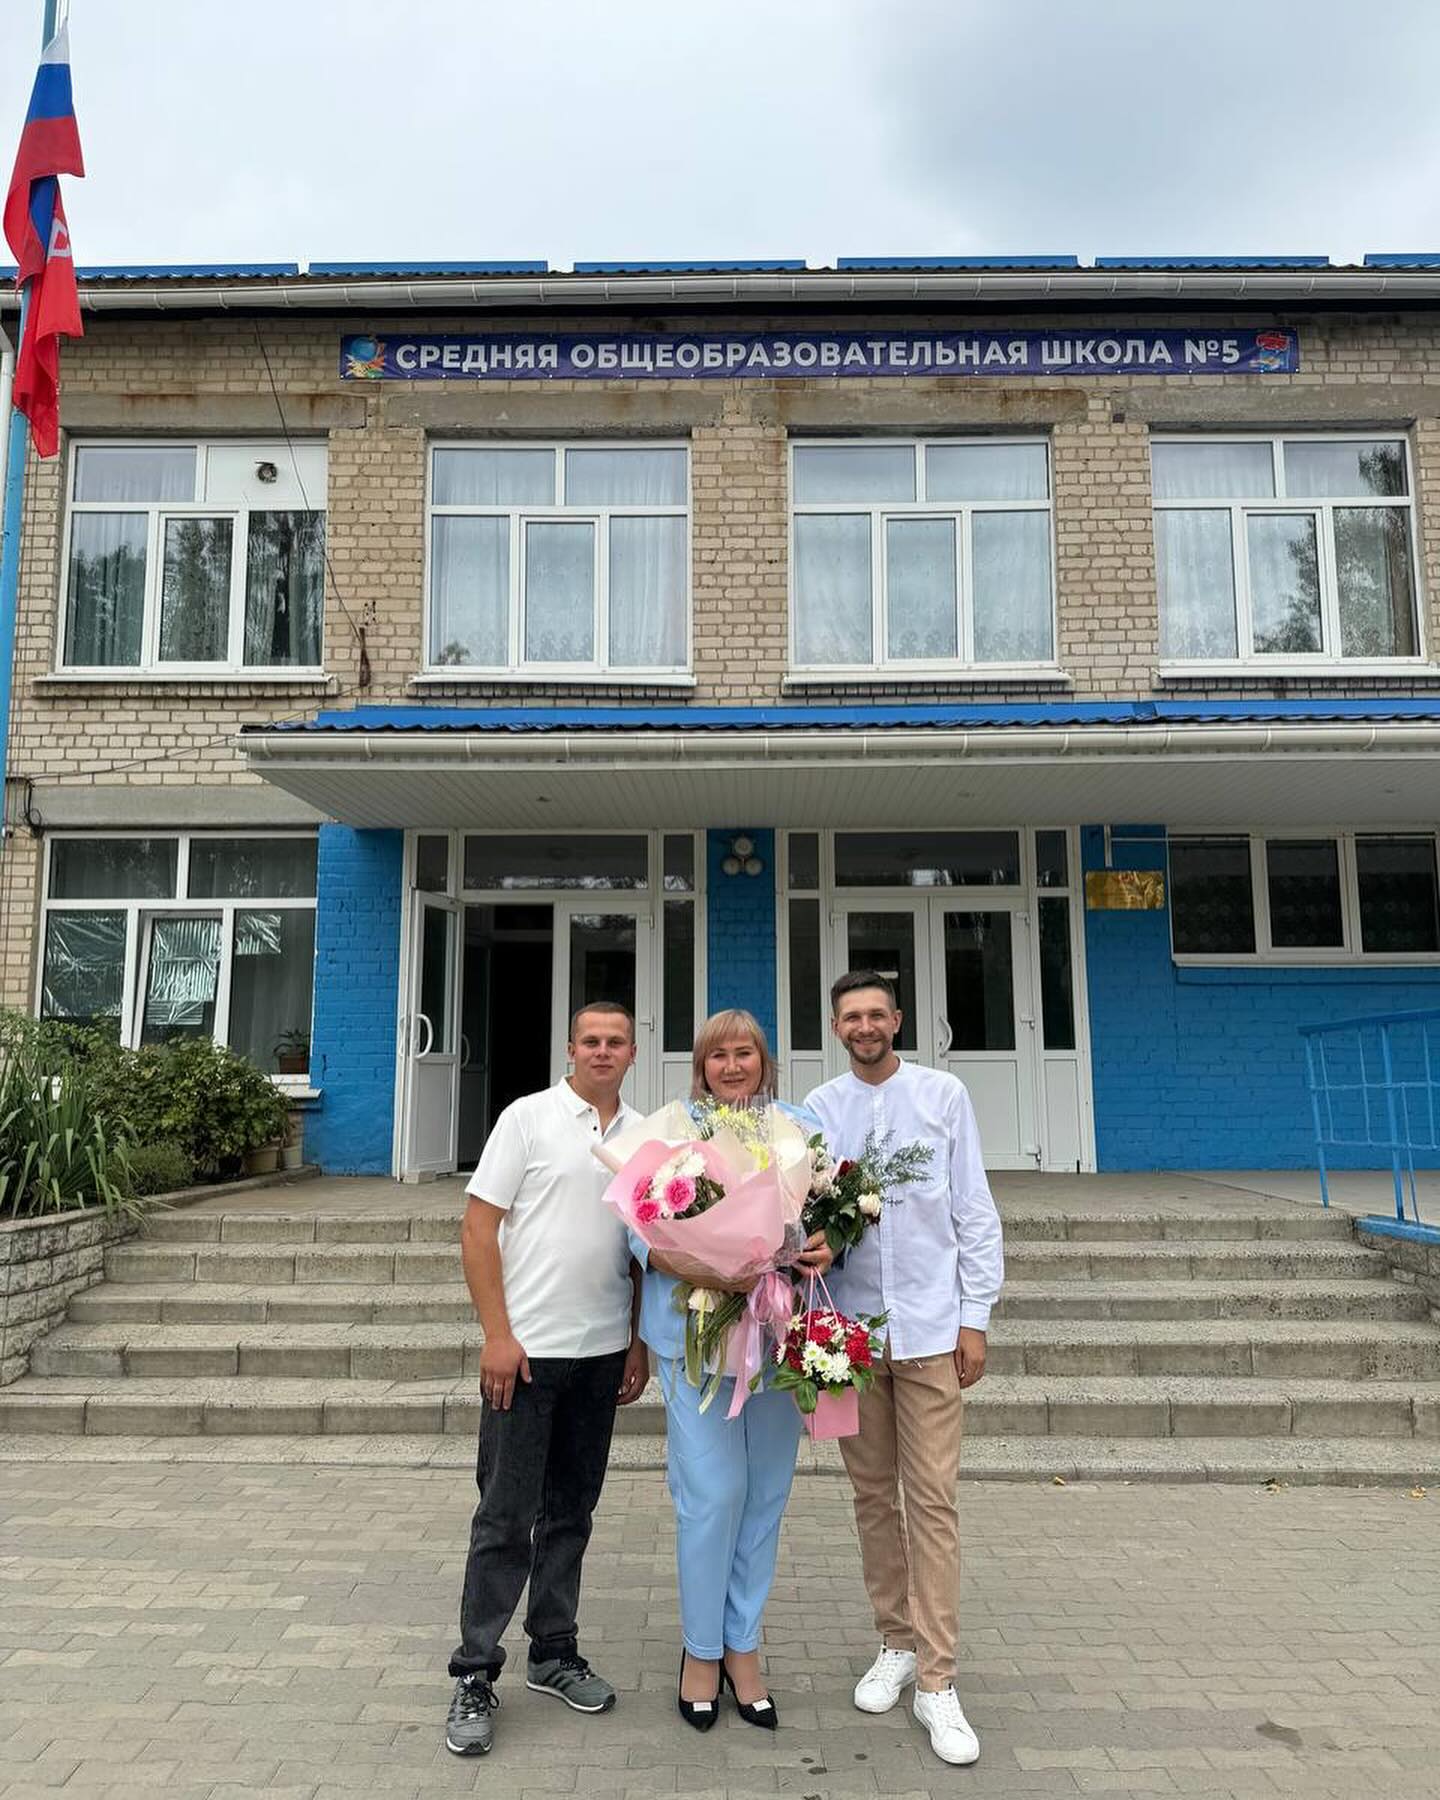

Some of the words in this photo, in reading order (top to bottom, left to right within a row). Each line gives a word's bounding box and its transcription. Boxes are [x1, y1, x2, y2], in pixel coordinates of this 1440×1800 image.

[395, 344, 559, 373] СРЕДНЯЯ
[570, 340, 1028, 373] ОБЩЕОБРАЗОВАТЕЛЬНАЯ
[1041, 339, 1173, 366] ШКОЛА
[1184, 339, 1241, 365] №5
